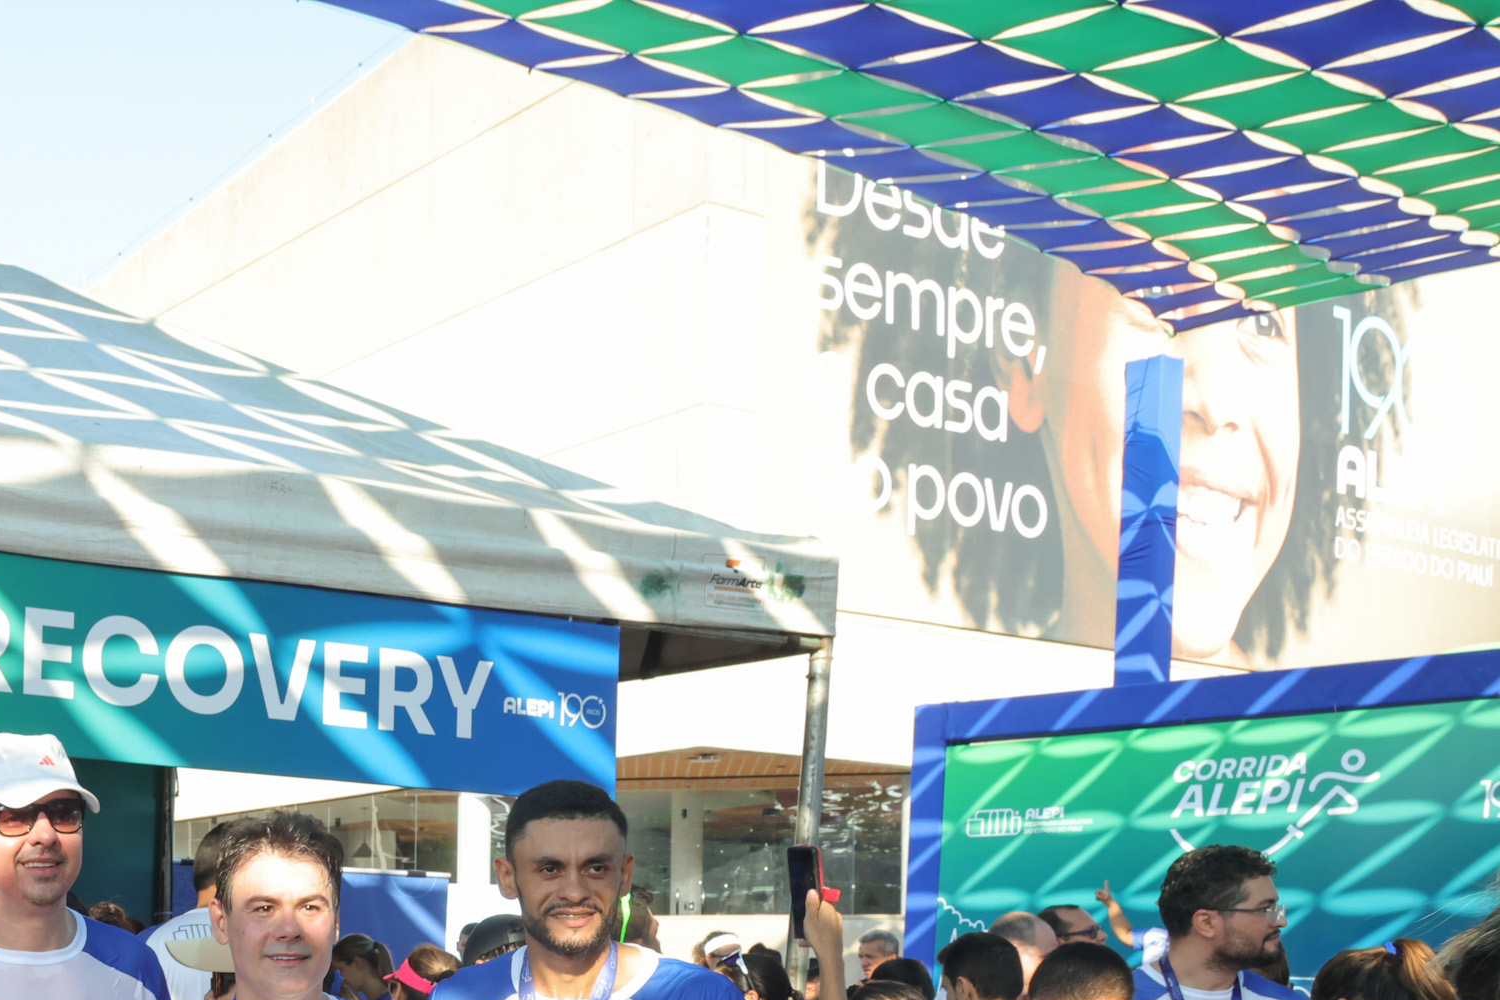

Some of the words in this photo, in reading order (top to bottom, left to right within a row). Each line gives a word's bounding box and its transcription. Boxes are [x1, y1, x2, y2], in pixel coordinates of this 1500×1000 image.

[817, 255, 1047, 374] sempre,
[867, 362, 1009, 443] casa
[908, 463, 1048, 538] povo
[1334, 536, 1361, 562] DO
[1430, 555, 1454, 580] DO
[503, 696, 555, 719] ALEPI
[558, 692, 606, 729] 190
[1172, 752, 1307, 784] CORRIDA
[1024, 806, 1065, 820] ALEPI
[1170, 777, 1305, 819] ALEPI
